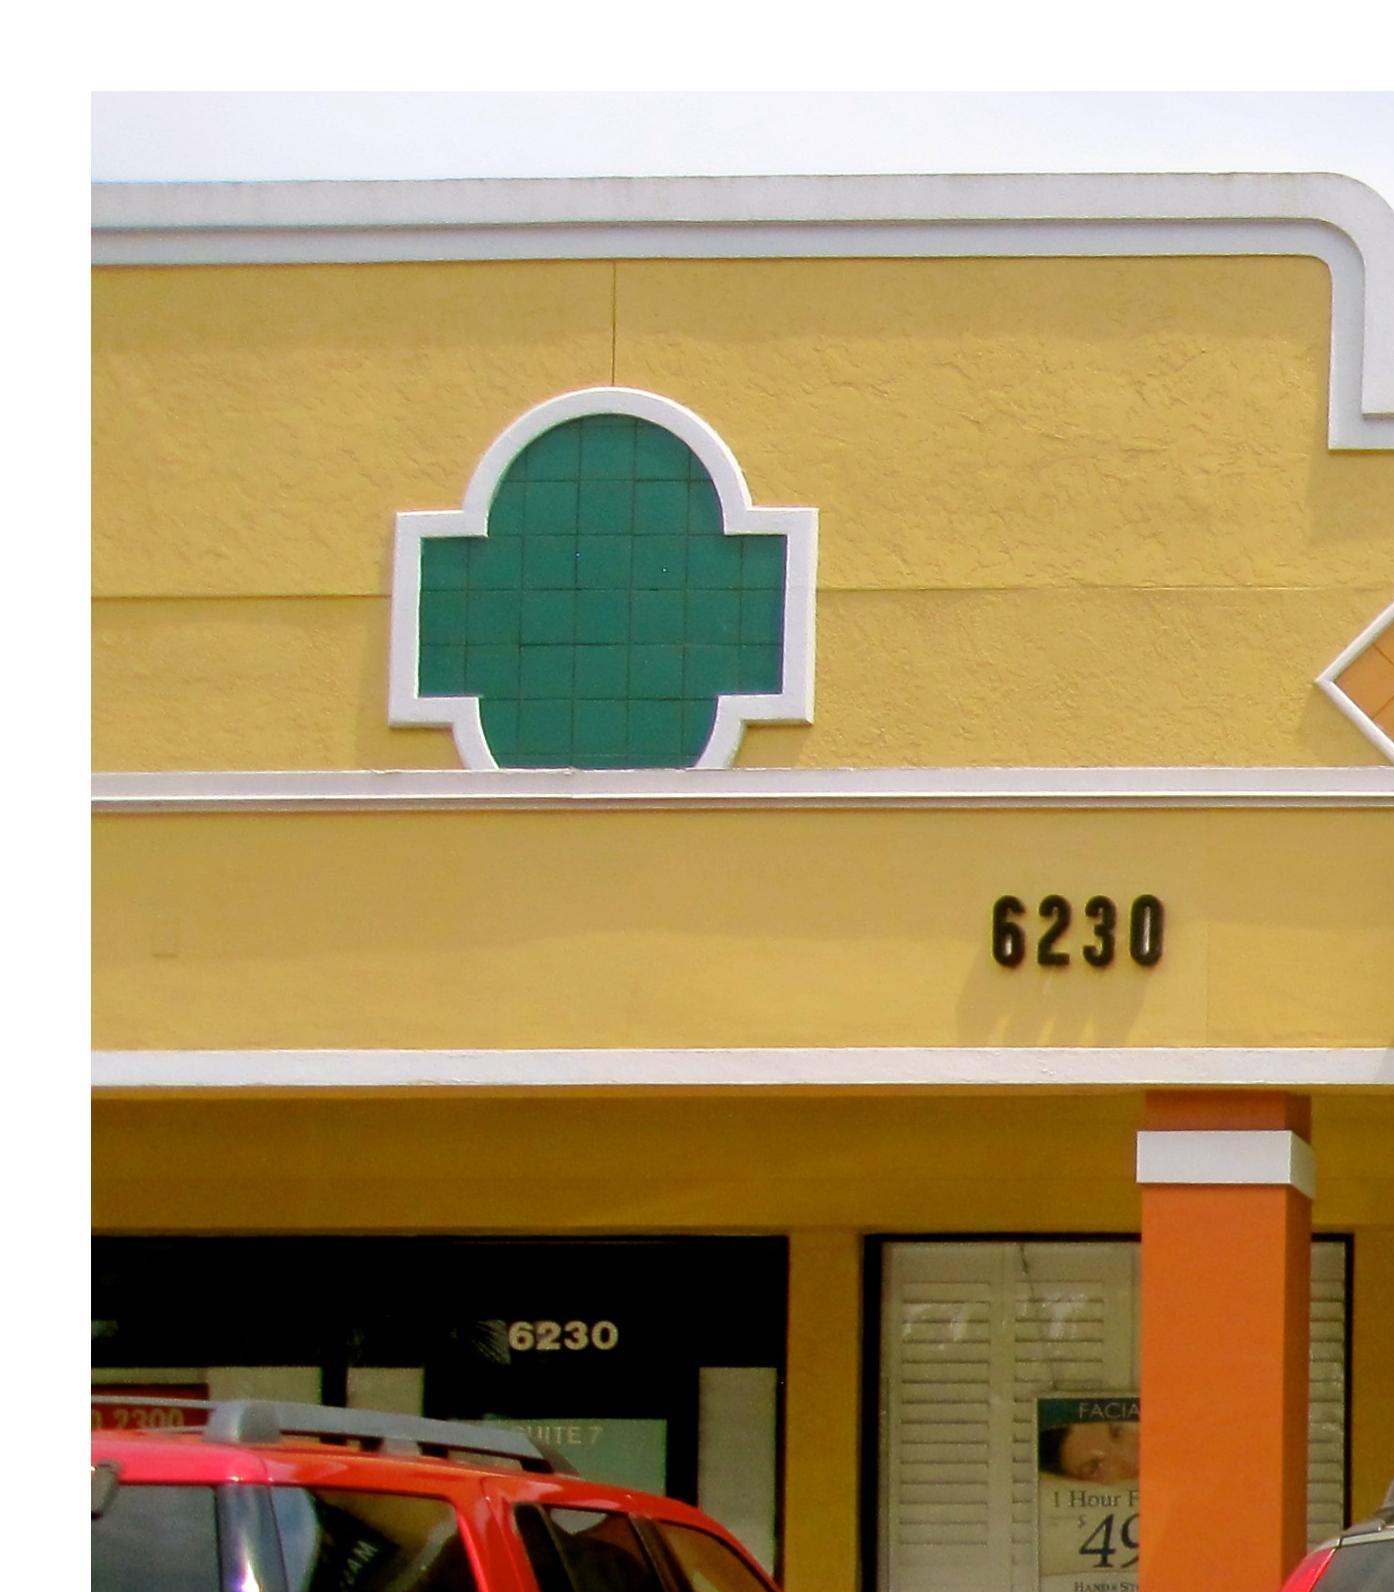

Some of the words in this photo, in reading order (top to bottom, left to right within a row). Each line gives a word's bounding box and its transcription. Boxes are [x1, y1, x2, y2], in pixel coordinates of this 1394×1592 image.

[991, 894, 1165, 968] 6230
[508, 1319, 620, 1352] 6230
[1079, 1402, 1139, 1418] FACIA
[516, 1425, 581, 1445] UITE
[1070, 1490, 1122, 1508] Hour
